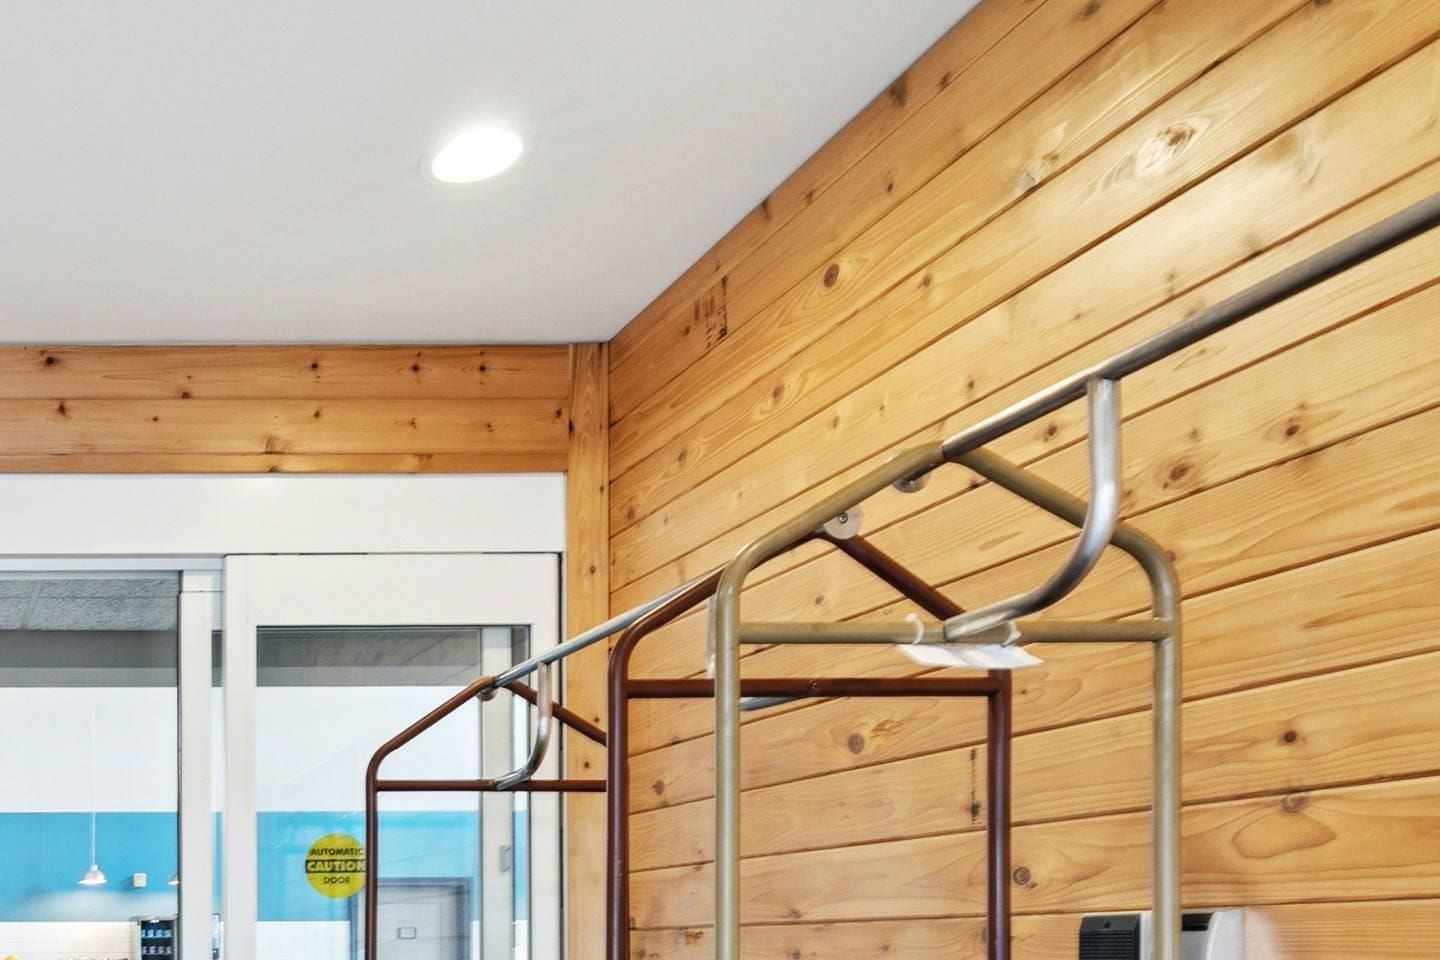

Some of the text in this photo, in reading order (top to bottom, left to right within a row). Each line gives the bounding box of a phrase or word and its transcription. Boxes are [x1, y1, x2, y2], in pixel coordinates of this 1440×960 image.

[310, 847, 364, 856] AUTOMATIC
[306, 860, 366, 872] CAUTION
[323, 876, 351, 884] DOOR
